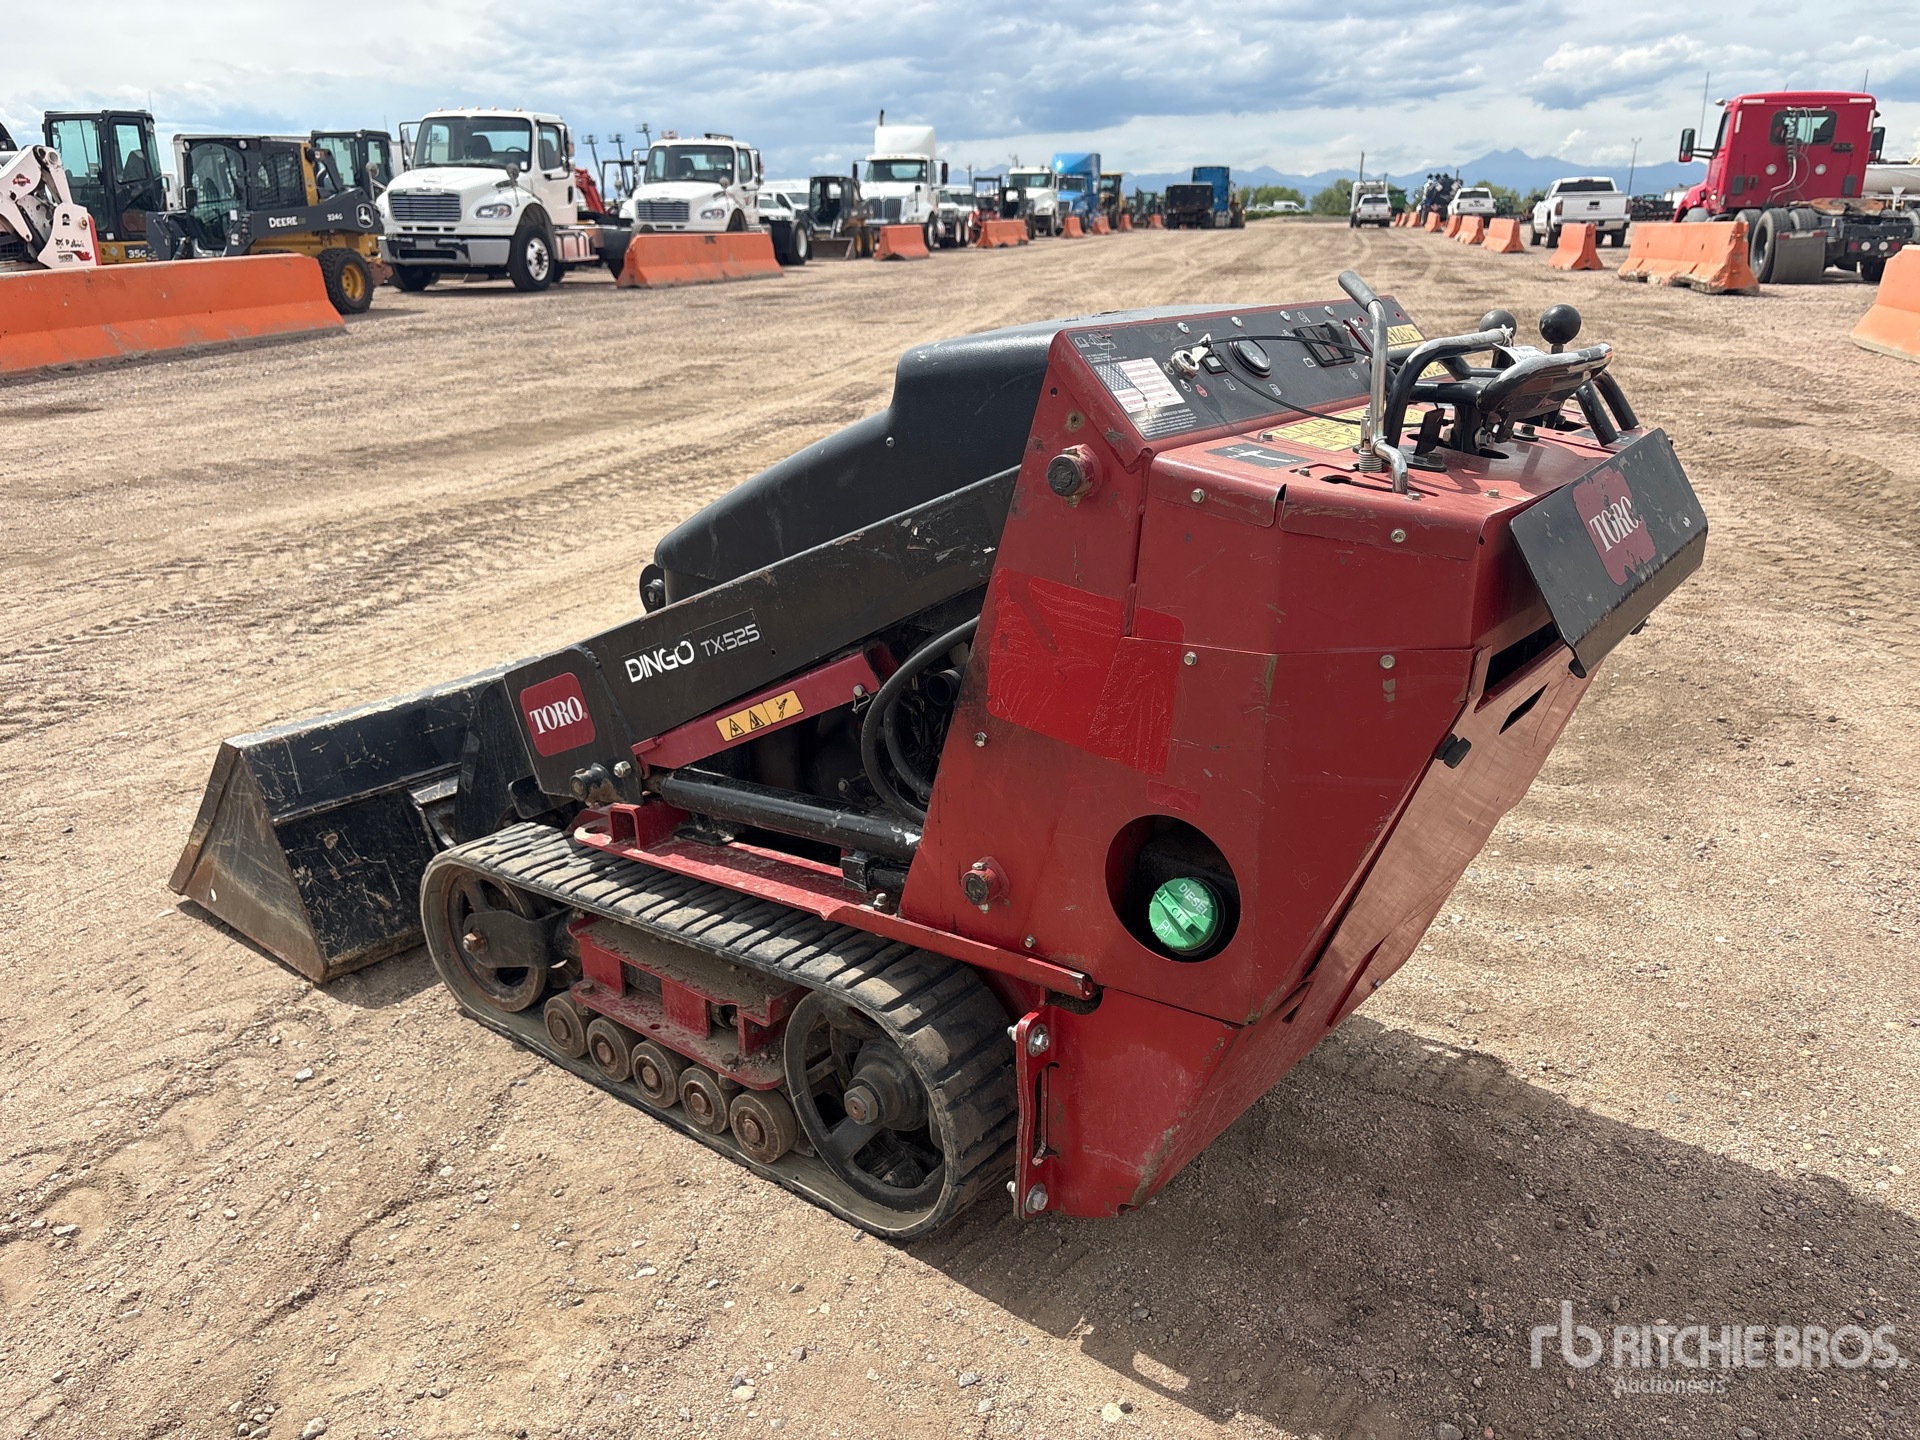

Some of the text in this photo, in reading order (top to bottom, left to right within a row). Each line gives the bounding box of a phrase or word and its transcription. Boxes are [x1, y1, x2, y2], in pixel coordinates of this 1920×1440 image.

[268, 215, 298, 228] DEERE
[625, 640, 695, 683] DINGO
[529, 696, 584, 735] TORO
[1178, 882, 1208, 919] DIESEL
